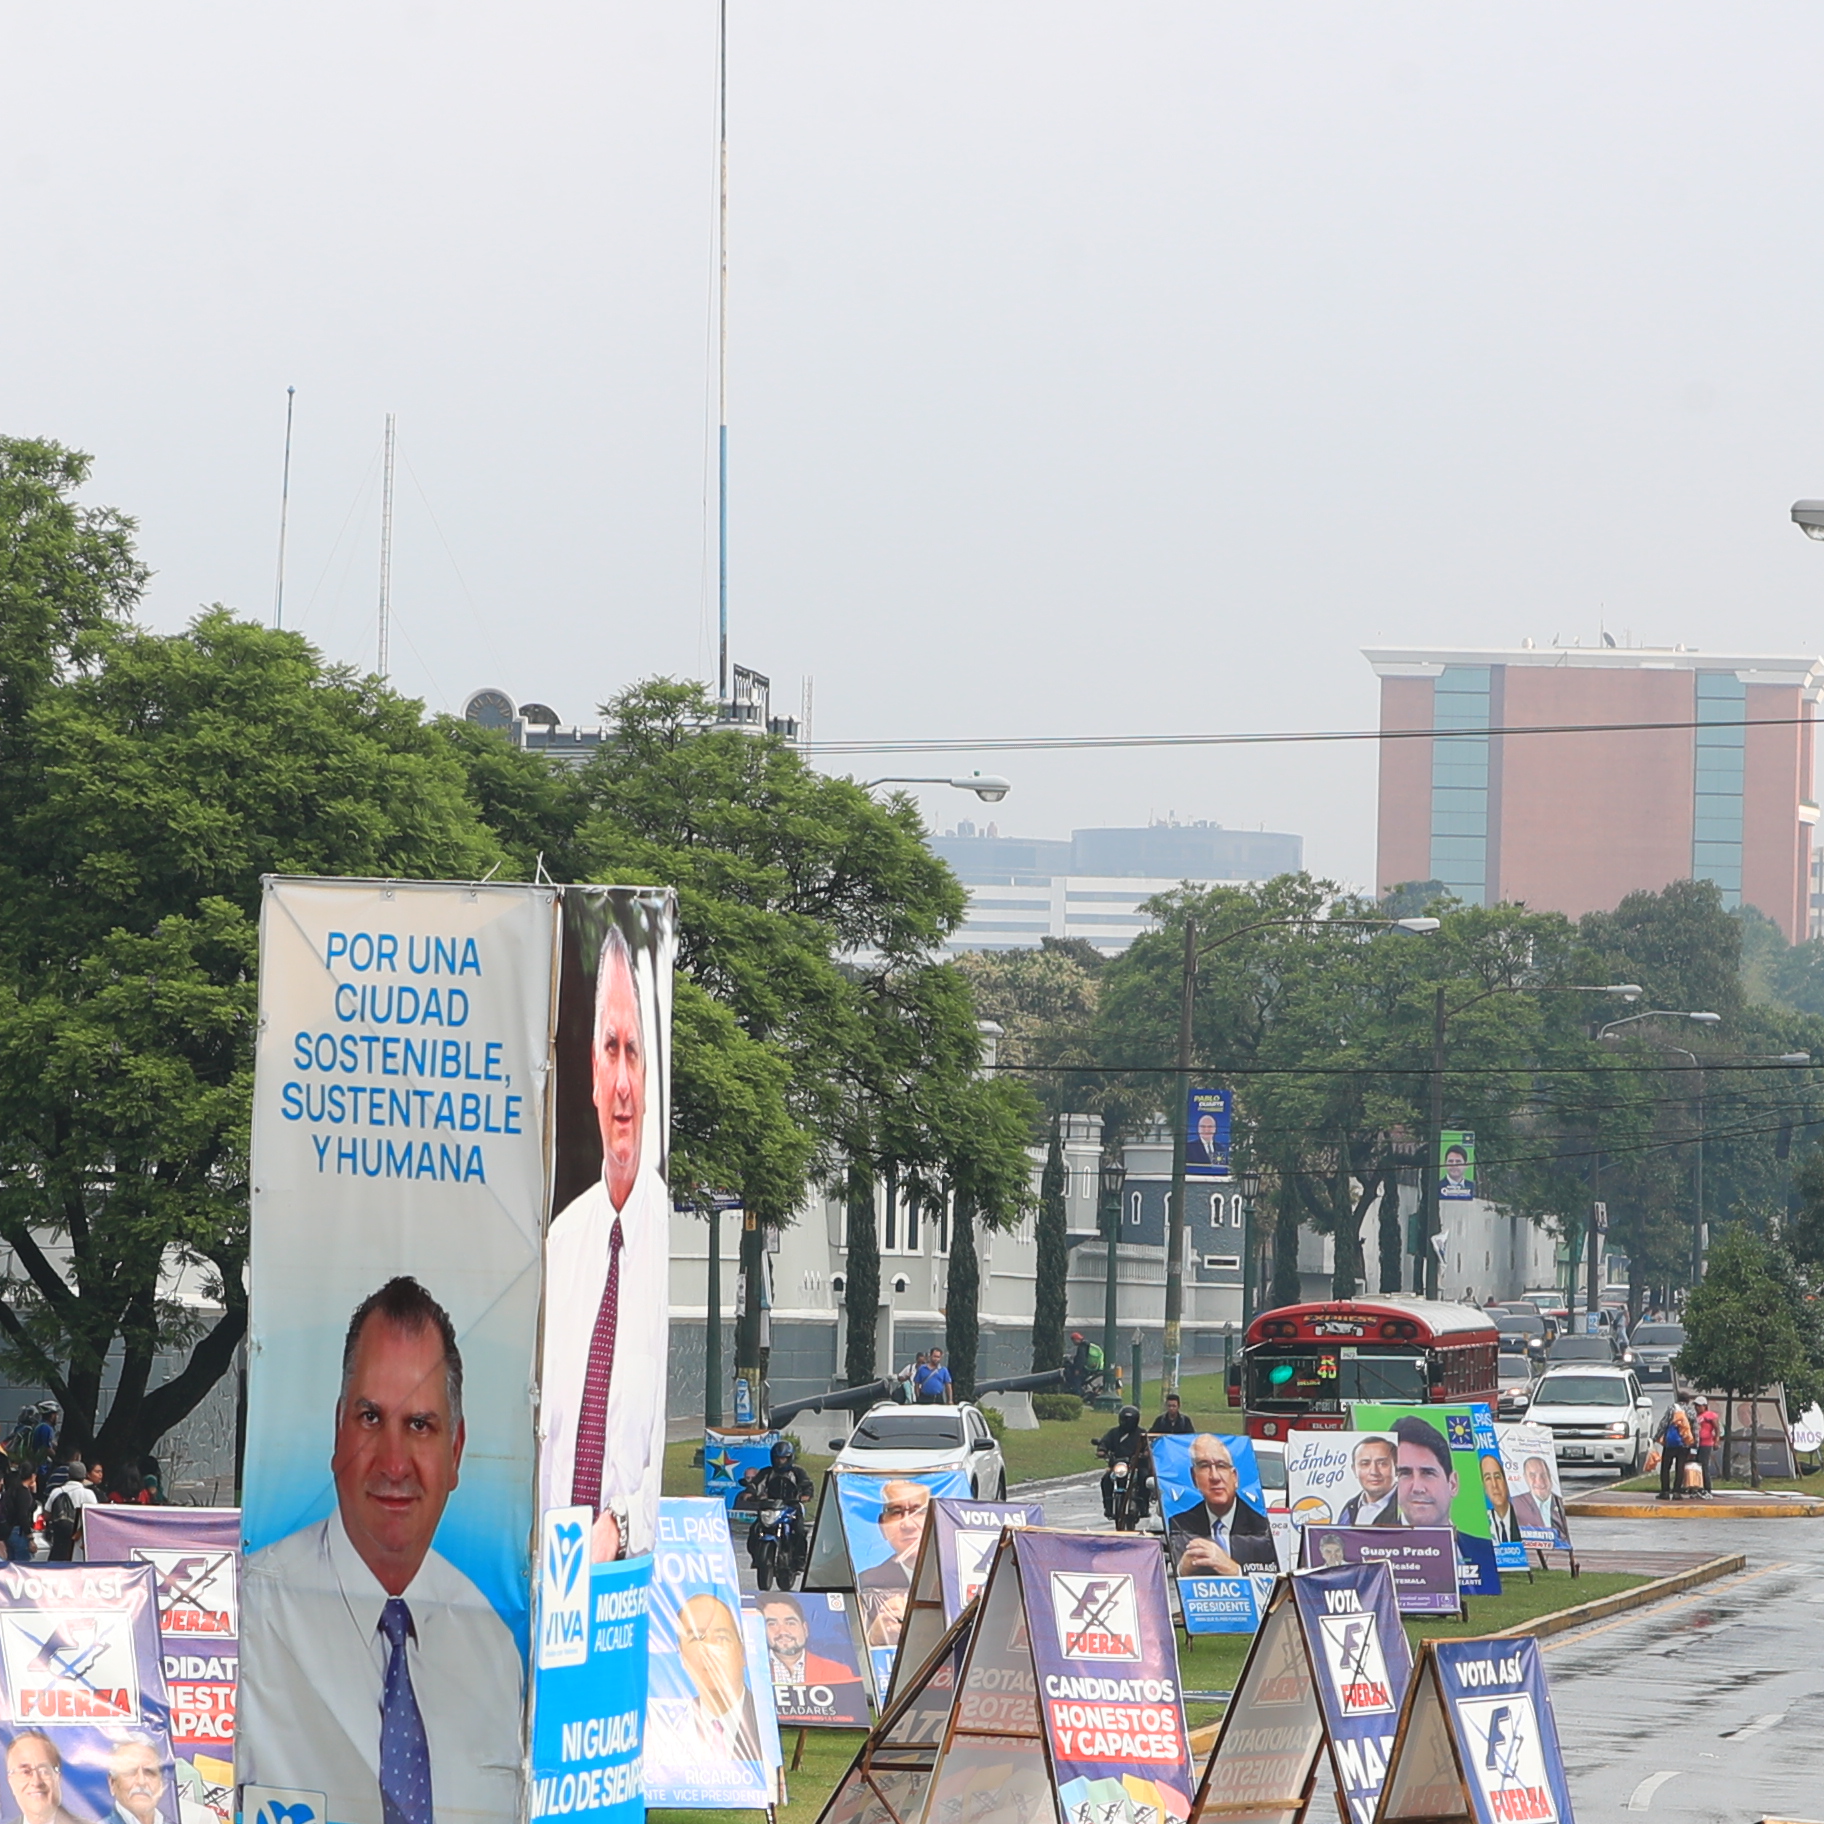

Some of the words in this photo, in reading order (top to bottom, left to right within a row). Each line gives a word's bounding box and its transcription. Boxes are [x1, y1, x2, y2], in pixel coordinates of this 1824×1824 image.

[326, 931, 398, 972] POR
[407, 934, 482, 977] UNA
[334, 983, 470, 1027] CIUDAD
[293, 1031, 511, 1089] SOSTENIBLE,
[280, 1081, 523, 1135] SUSTENTABLE
[311, 1134, 332, 1173] Y
[337, 1135, 487, 1184] HUMANA
[1289, 1449, 1348, 1473] cambio
[1303, 1441, 1320, 1458] El
[1306, 1466, 1346, 1489] llegó
[660, 1517, 684, 1543] EL
[684, 1514, 728, 1544] PAÍS
[960, 1509, 1001, 1527] VOTA
[1003, 1509, 1026, 1527] ASÍ
[1360, 1546, 1400, 1558] Guayo
[1402, 1546, 1441, 1557] Prado
[1391, 1562, 1422, 1571] lcalde
[6, 1575, 75, 1601] VOTA
[81, 1573, 123, 1600] ASÍ
[1192, 1581, 1242, 1599] ISAAC
[1325, 1588, 1363, 1614] VOTA
[595, 1583, 638, 1623] MOISÉS
[1188, 1601, 1252, 1613] PRESIDENTE
[161, 1608, 232, 1634] UERZA
[593, 1622, 635, 1653] ALCALDE
[1064, 1630, 1136, 1656] FUERZA
[1454, 1660, 1498, 1688] VOTA
[1499, 1650, 1523, 1685] ASÍ
[20, 1687, 132, 1718] FUERZA
[775, 1685, 835, 1707] ETO
[1045, 1674, 1176, 1703] CANDIDATOS
[1340, 1680, 1389, 1708] FUERZA
[1054, 1703, 1177, 1733] HONESTOS
[562, 1721, 583, 1763] NI
[1057, 1730, 1072, 1757] Y
[1076, 1731, 1181, 1760] CAPACES
[684, 1769, 754, 1786] RICARDO
[547, 1773, 576, 1816] LO
[576, 1769, 603, 1811] DE
[672, 1788, 699, 1802] VICE
[1489, 1785, 1554, 1823] FUERZA
